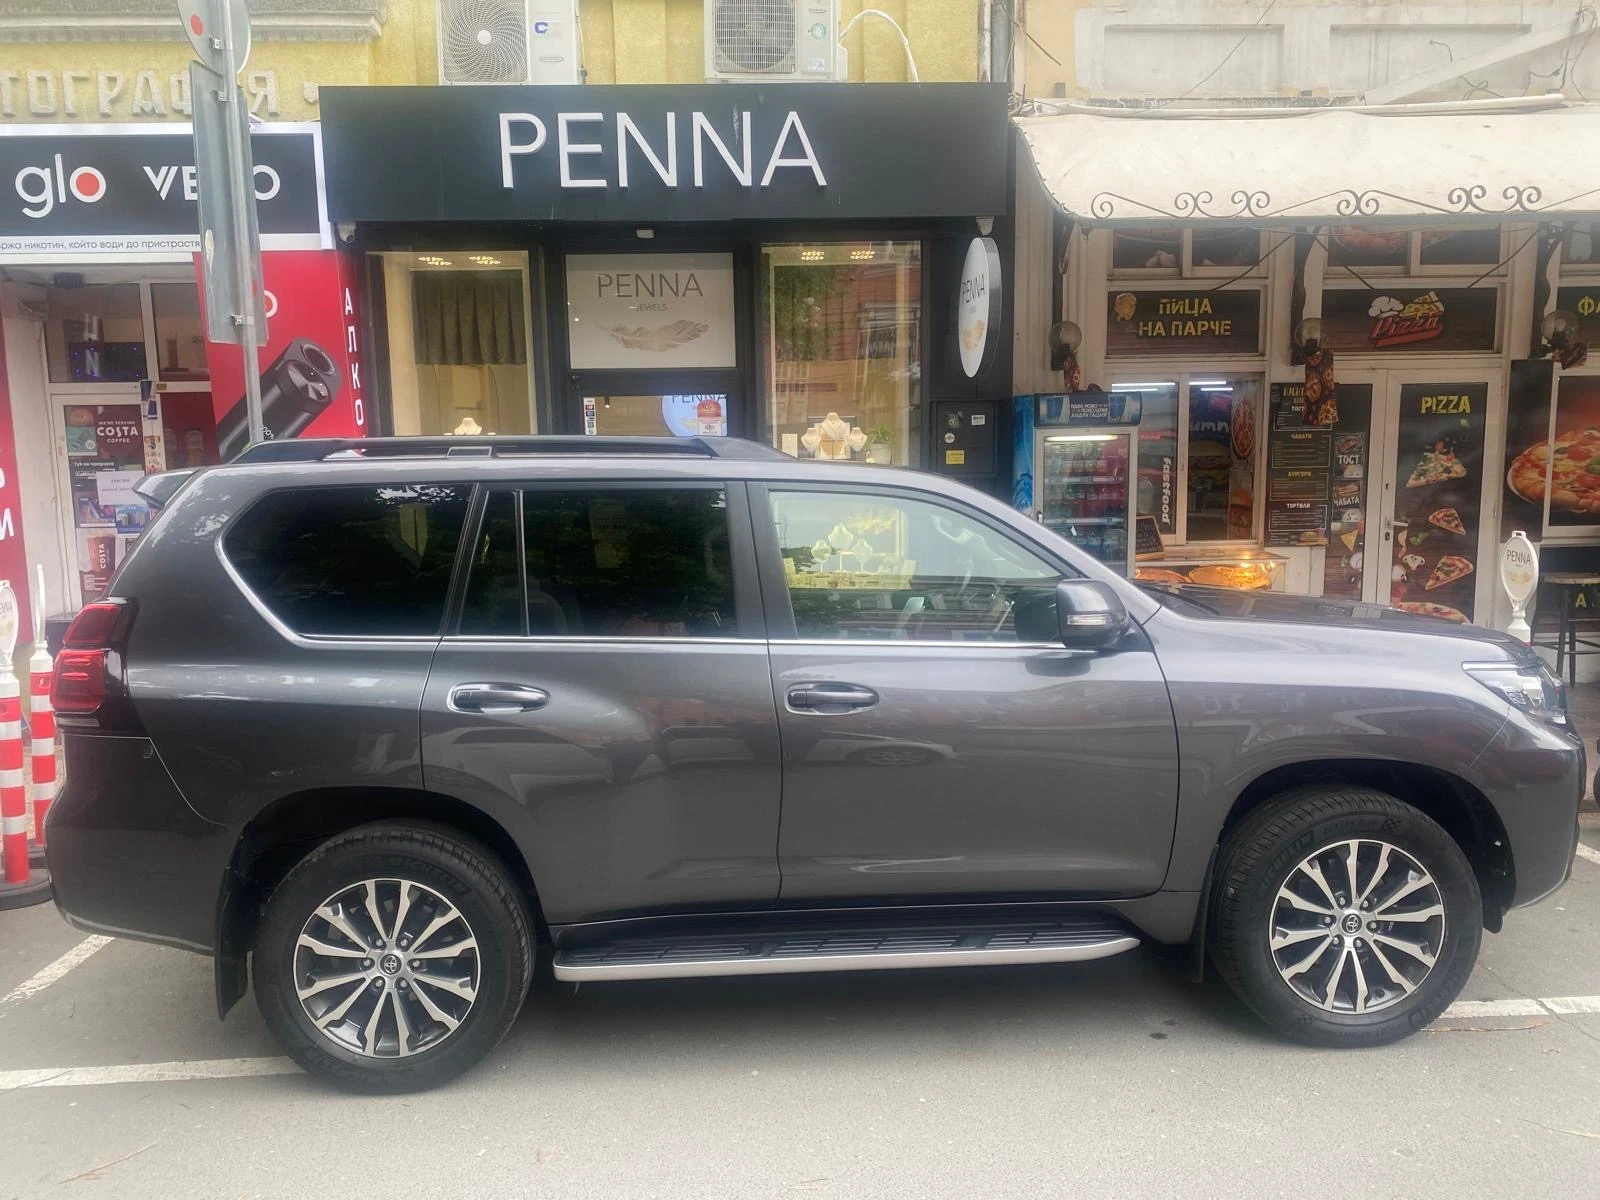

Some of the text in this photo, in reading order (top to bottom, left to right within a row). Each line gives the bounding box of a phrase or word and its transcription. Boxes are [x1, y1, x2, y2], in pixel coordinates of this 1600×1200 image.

[0, 69, 280, 117] ТОГРАФЯ
[499, 111, 827, 188] PENNA
[15, 153, 106, 218] glo
[143, 165, 280, 200] VEO
[69, 239, 97, 249] който
[100, 240, 123, 250] води
[126, 241, 139, 250] до
[597, 273, 703, 298] PENNA
[962, 273, 985, 303] PENNA
[1159, 298, 1213, 317] ПИЦА
[1138, 320, 1232, 337] НА ПАРЧЕ
[1369, 315, 1440, 340] Pizza
[345, 287, 364, 438] АЛКО
[1420, 395, 1471, 414] PIZZA
[97, 426, 139, 437] COSTA
[1338, 454, 1360, 465] ТОСТ
[1333, 496, 1360, 507] ЧАБАТА
[98, 543, 106, 569] COSTA
[1506, 550, 1531, 565] PENNA
